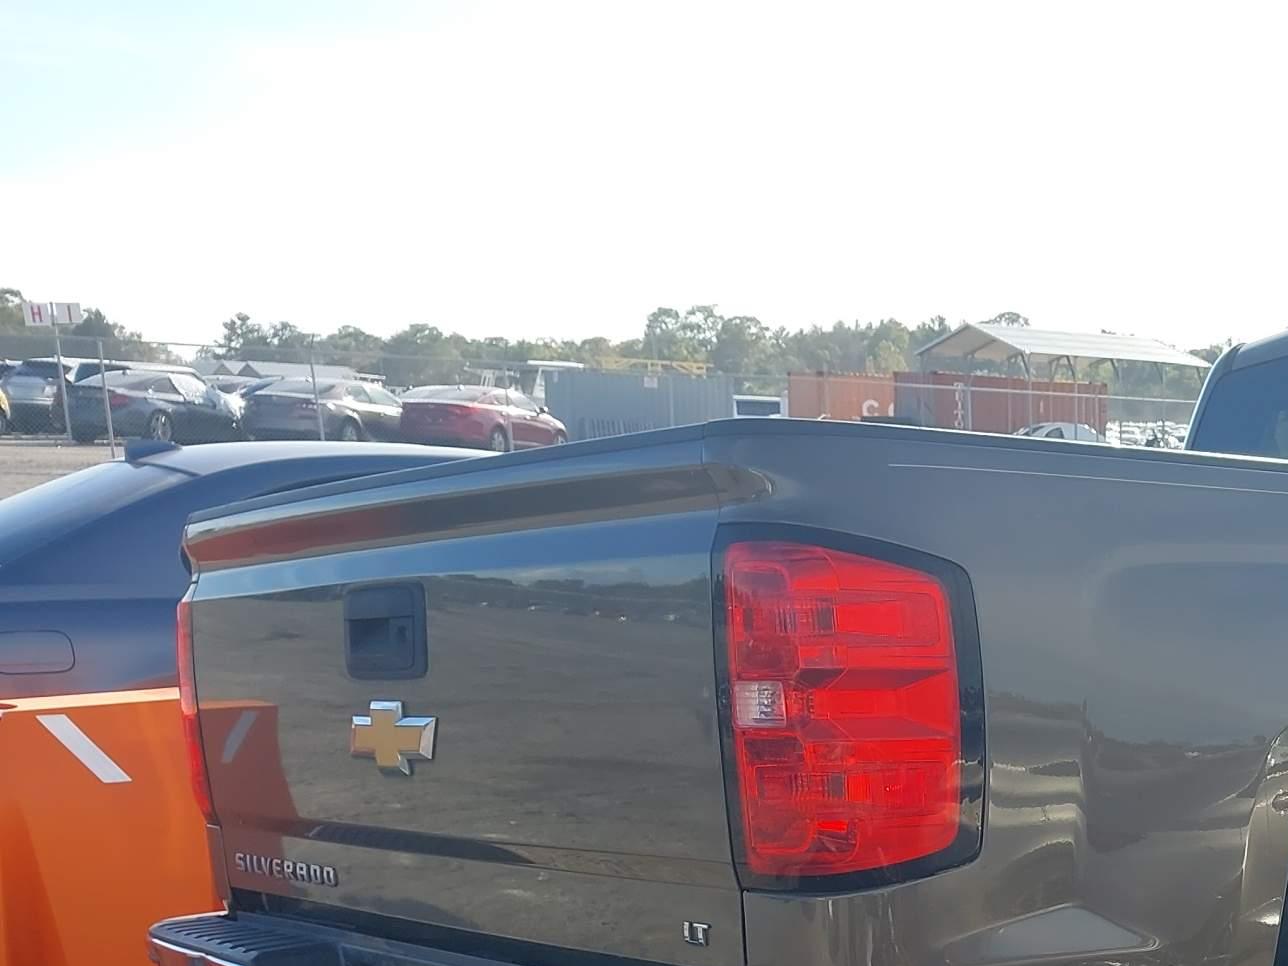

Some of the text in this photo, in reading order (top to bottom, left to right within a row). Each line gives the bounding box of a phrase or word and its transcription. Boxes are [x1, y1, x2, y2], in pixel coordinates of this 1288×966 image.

[30, 305, 43, 323] H
[234, 852, 337, 887] SILVERADO
[682, 921, 710, 946] LT
